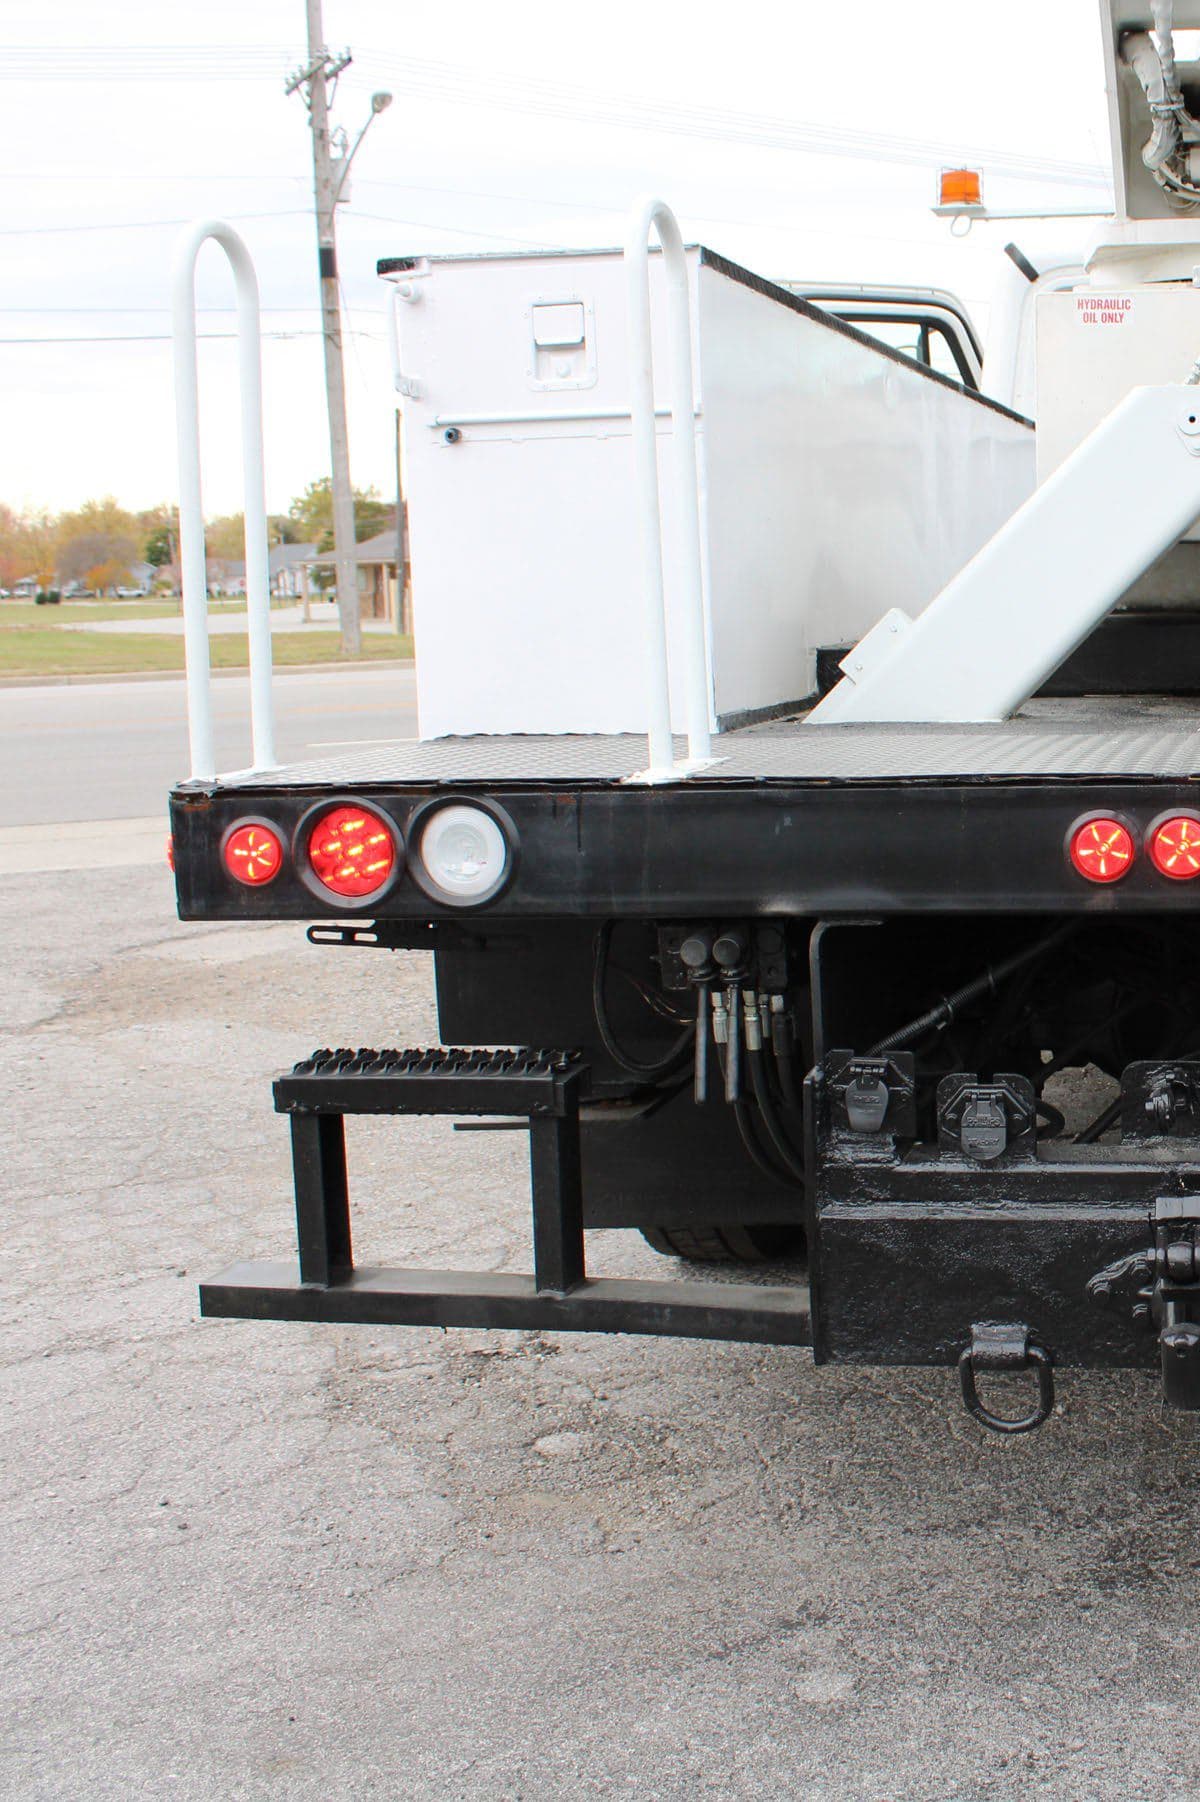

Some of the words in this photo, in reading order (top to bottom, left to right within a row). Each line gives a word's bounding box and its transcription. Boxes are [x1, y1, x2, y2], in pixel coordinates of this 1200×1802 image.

[1077, 299, 1131, 310] HYDRAULIC
[1083, 312, 1098, 323] OIL
[1101, 312, 1124, 323] ONLY
